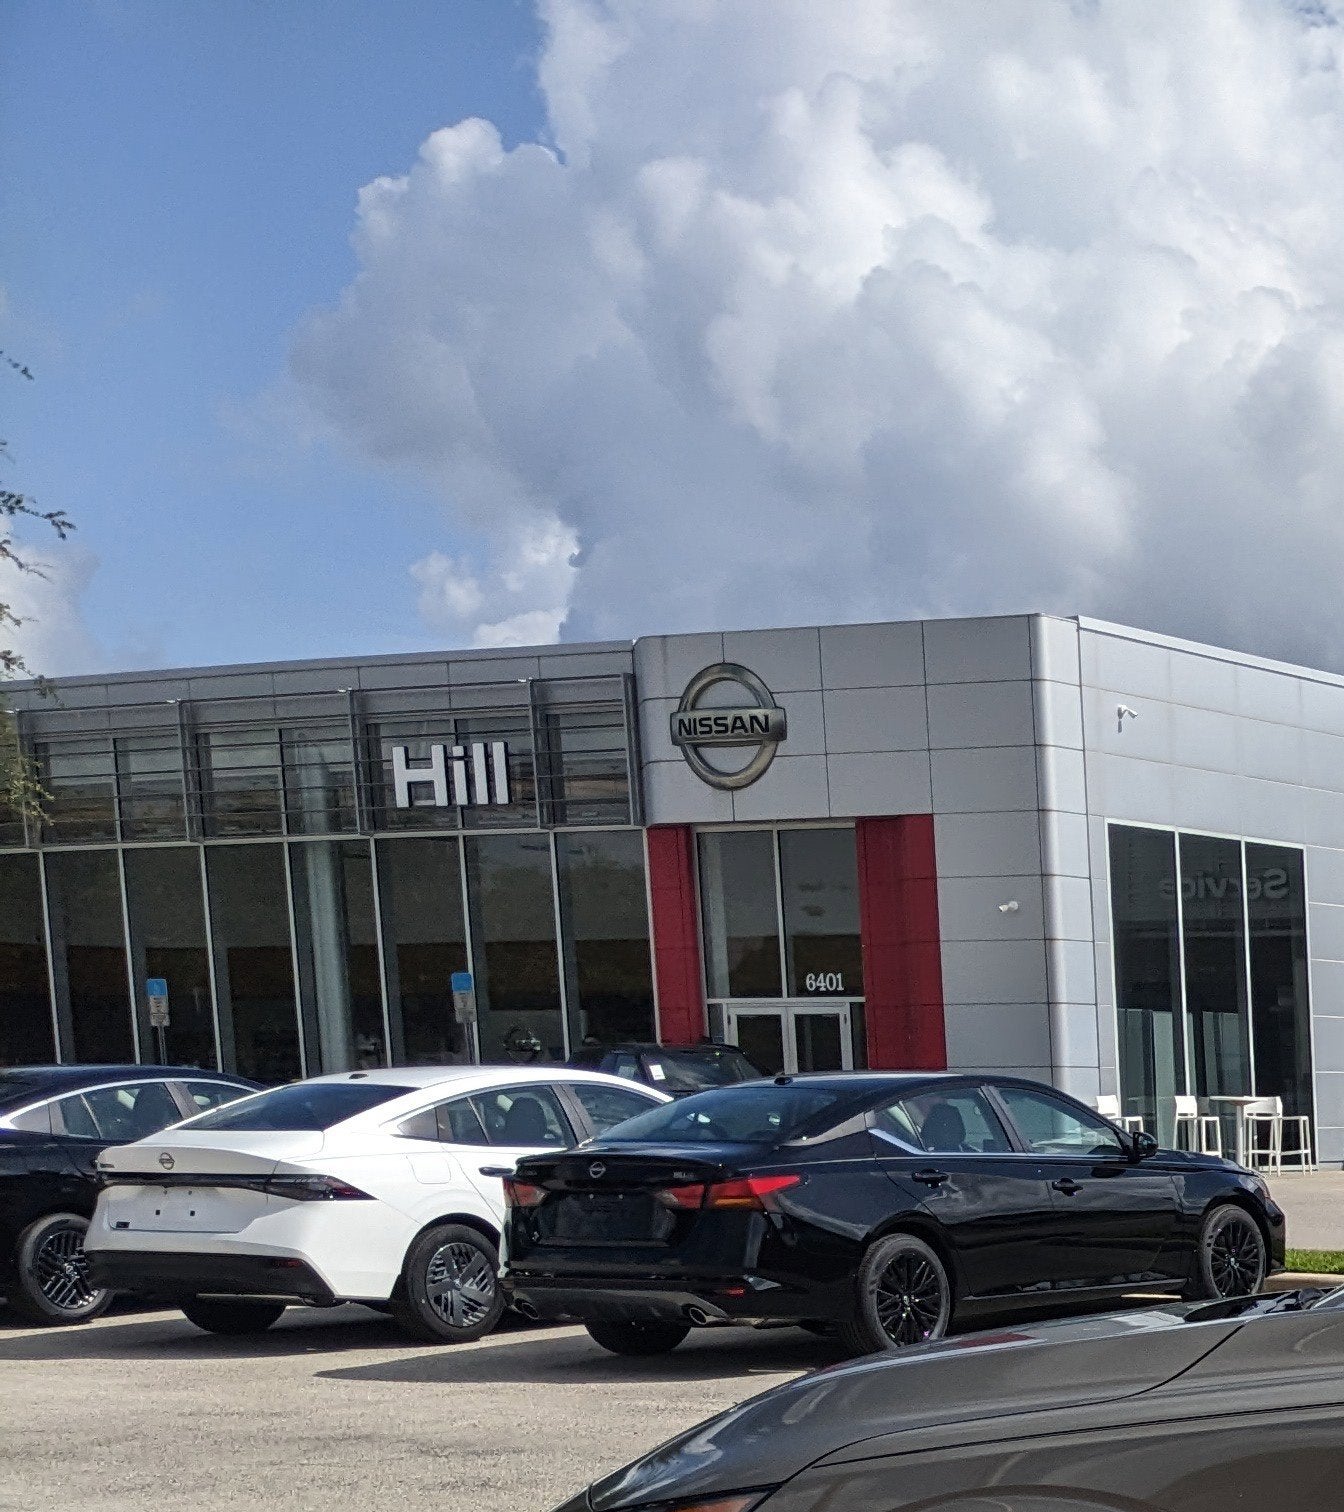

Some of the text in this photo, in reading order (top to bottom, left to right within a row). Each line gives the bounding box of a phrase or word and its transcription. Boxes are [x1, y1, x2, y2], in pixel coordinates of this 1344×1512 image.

[678, 713, 770, 736] NISSAN
[392, 741, 509, 808] Hill
[806, 972, 845, 991] 6401
